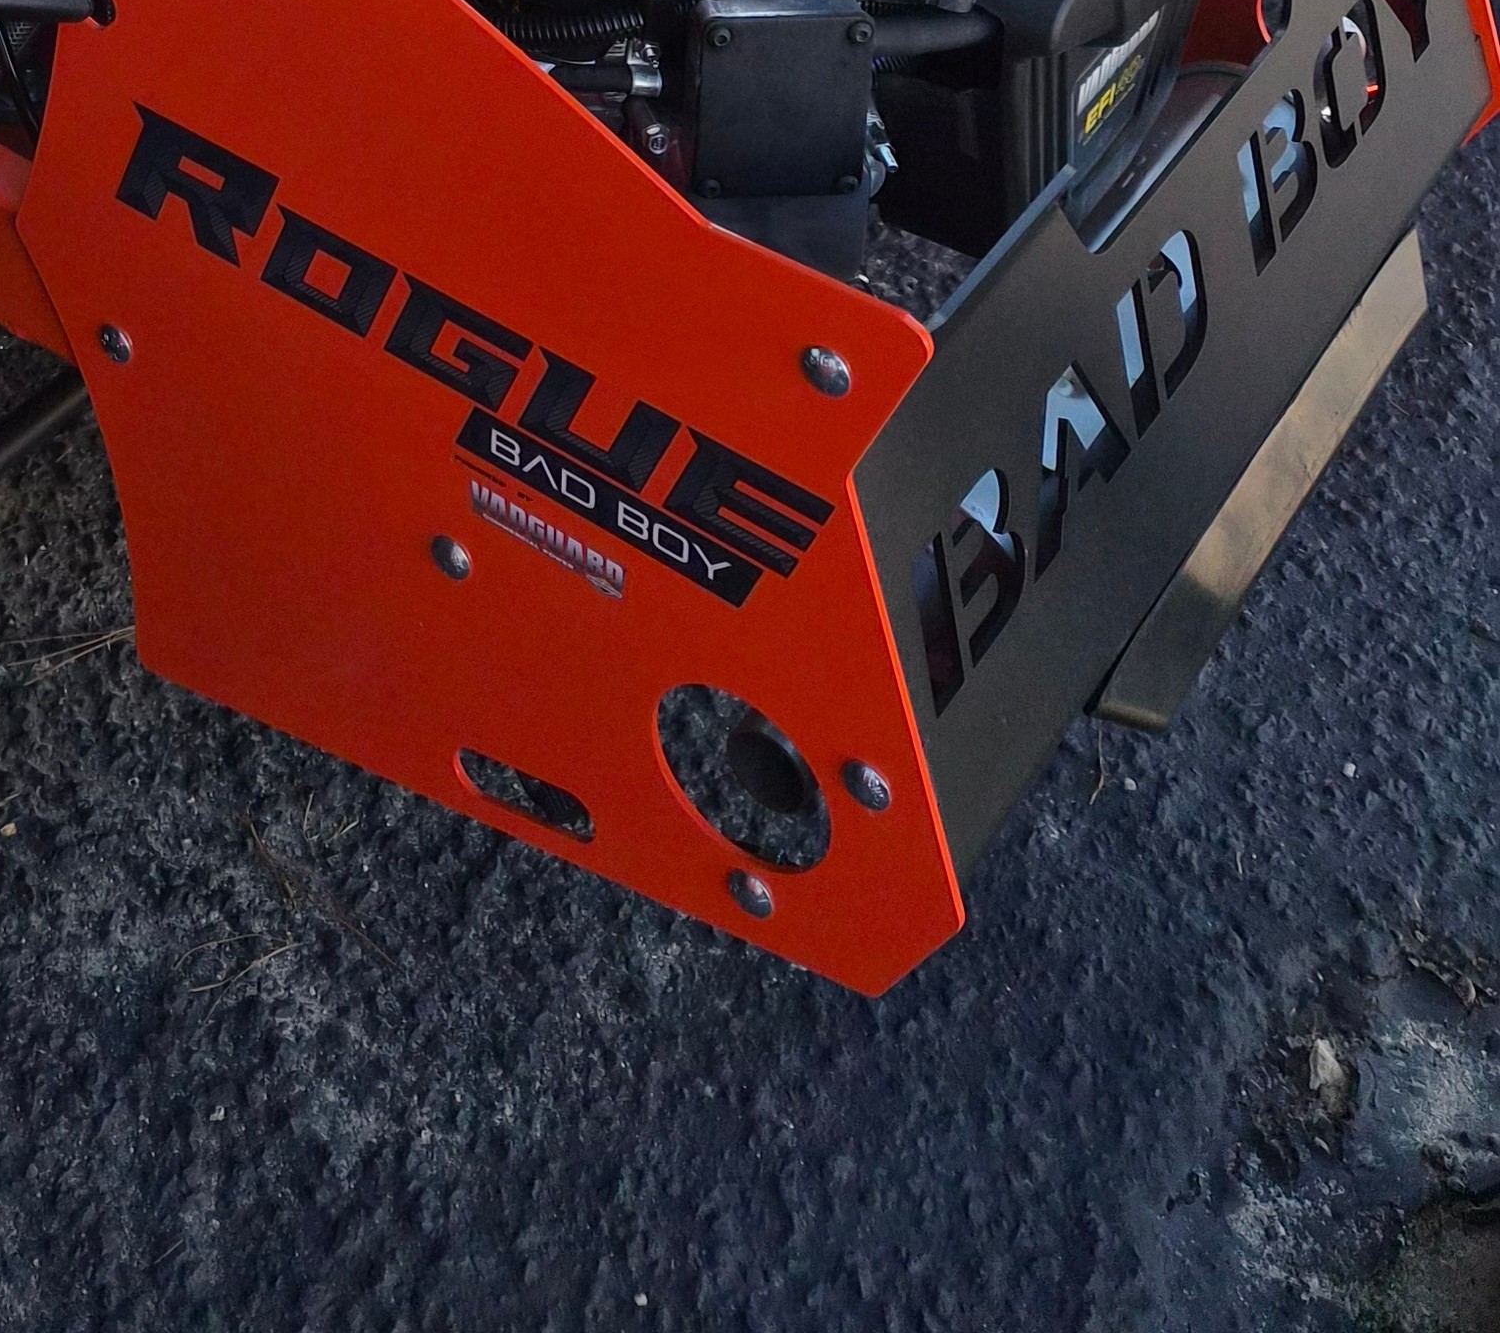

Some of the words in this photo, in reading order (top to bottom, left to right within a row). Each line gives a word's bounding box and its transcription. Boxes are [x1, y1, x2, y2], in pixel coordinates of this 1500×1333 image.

[1085, 82, 1117, 134] EFI
[114, 100, 836, 579] ROGUE
[470, 479, 625, 585] VANGUARD
[490, 427, 596, 510] BAD
[617, 500, 732, 581] BOY
[912, 227, 1208, 717] BAD
